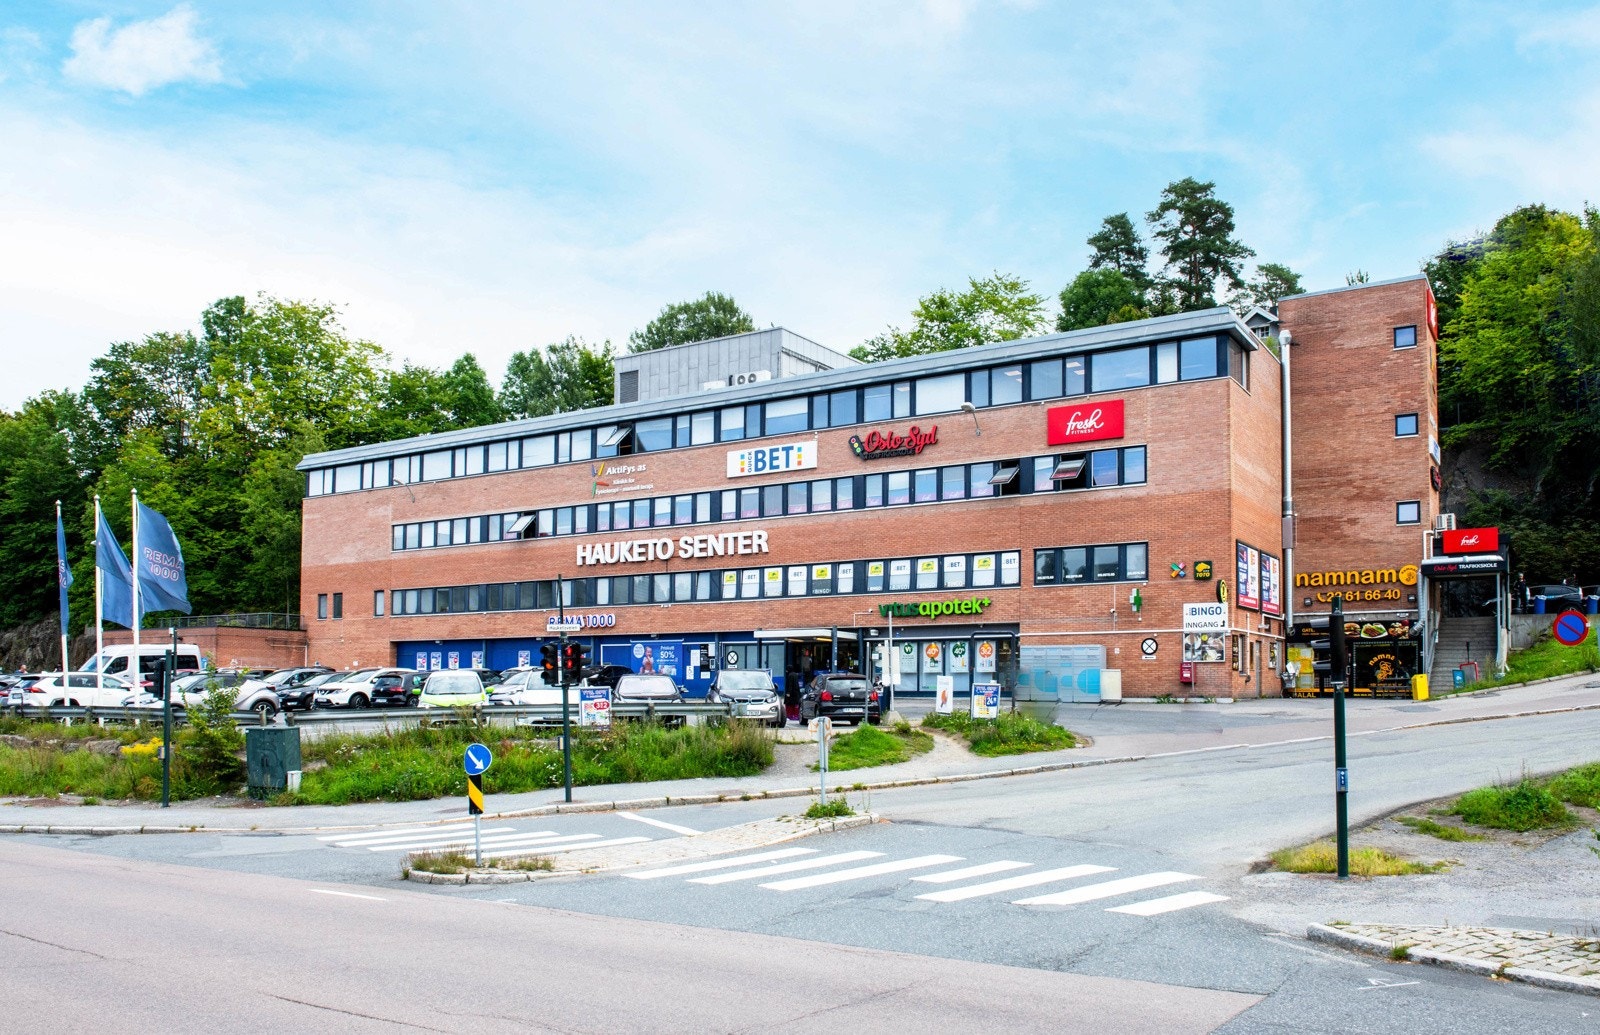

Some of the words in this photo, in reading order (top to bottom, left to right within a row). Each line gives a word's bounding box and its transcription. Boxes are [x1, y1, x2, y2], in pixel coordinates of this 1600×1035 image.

[1065, 408, 1104, 436] fresh
[863, 430, 904, 453] Oslo
[905, 425, 938, 455] Syd
[754, 446, 794, 472] BET
[605, 464, 636, 475] AktiFys
[637, 464, 647, 472] as
[576, 537, 675, 566] HAUKETO
[678, 530, 769, 559] SENTER
[148, 561, 179, 582] 1000
[1295, 568, 1397, 587] namnam
[1345, 590, 1361, 601] 61
[1364, 589, 1381, 600] 66
[1384, 588, 1400, 600] 40
[586, 613, 615, 628] 1000
[1191, 606, 1222, 616] BINGO
[660, 651, 675, 659] 50%
